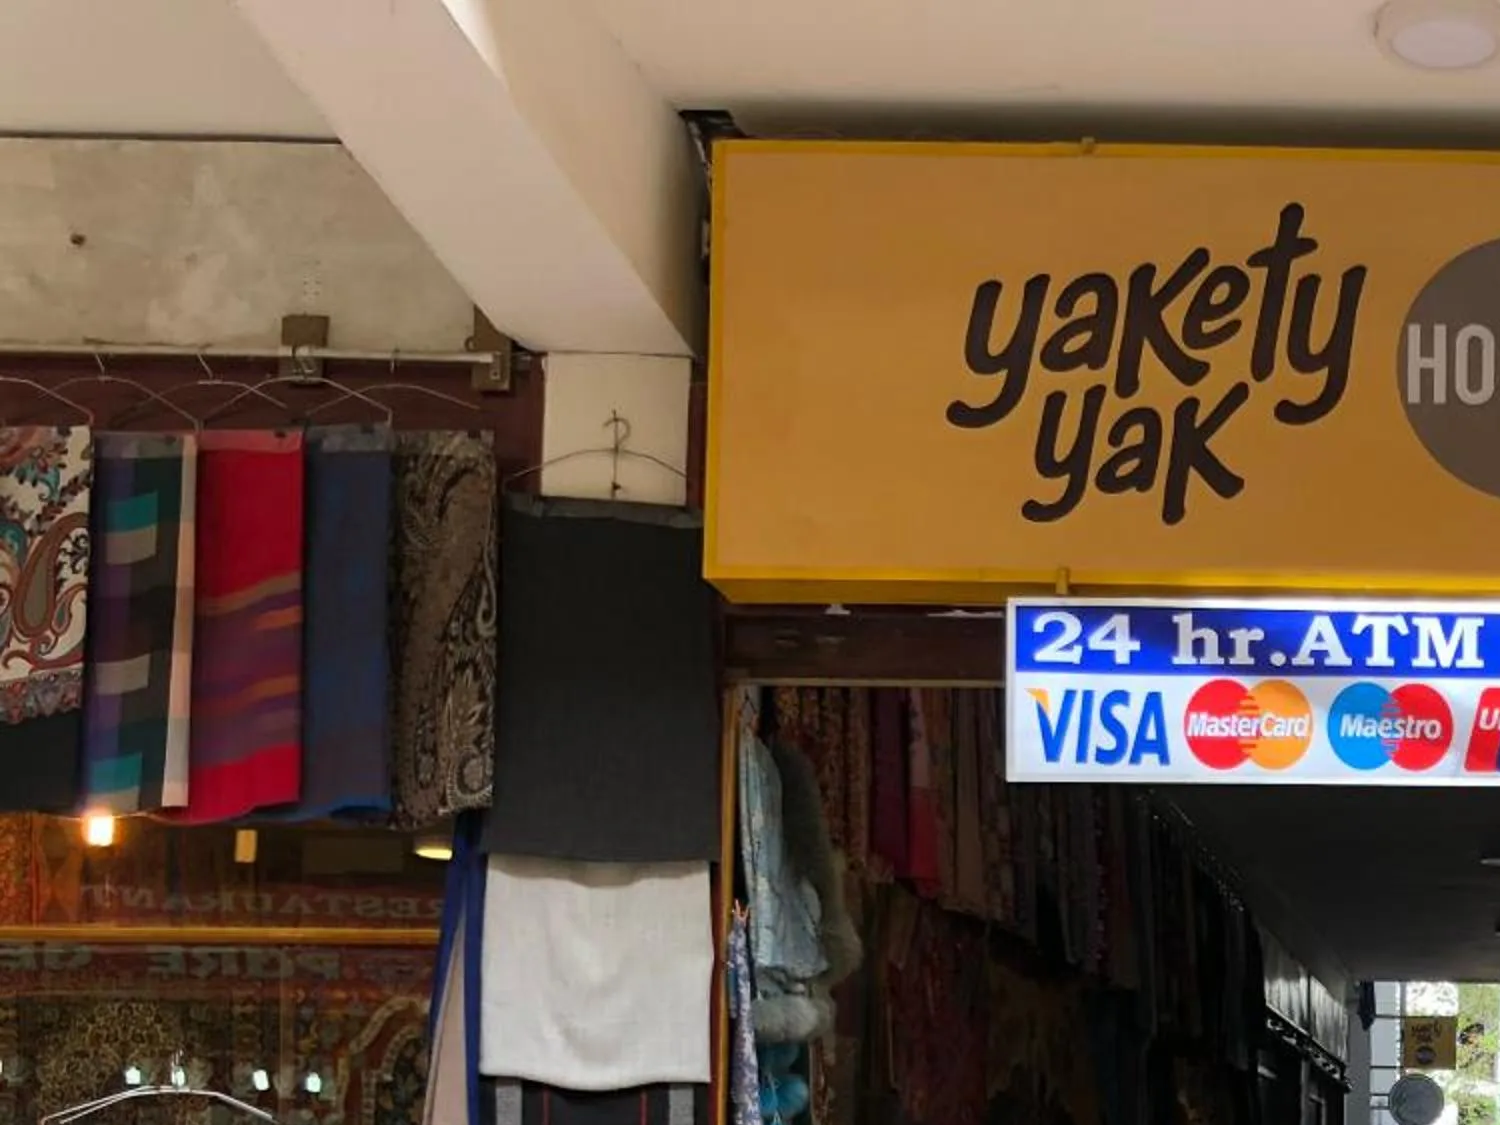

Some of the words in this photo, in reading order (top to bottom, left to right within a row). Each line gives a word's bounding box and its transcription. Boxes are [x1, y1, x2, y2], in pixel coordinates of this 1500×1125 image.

[1032, 611, 1140, 666] 24
[1024, 687, 1171, 766] VISA
[1187, 713, 1310, 738] MasterCard
[1339, 713, 1443, 740] Maestro
